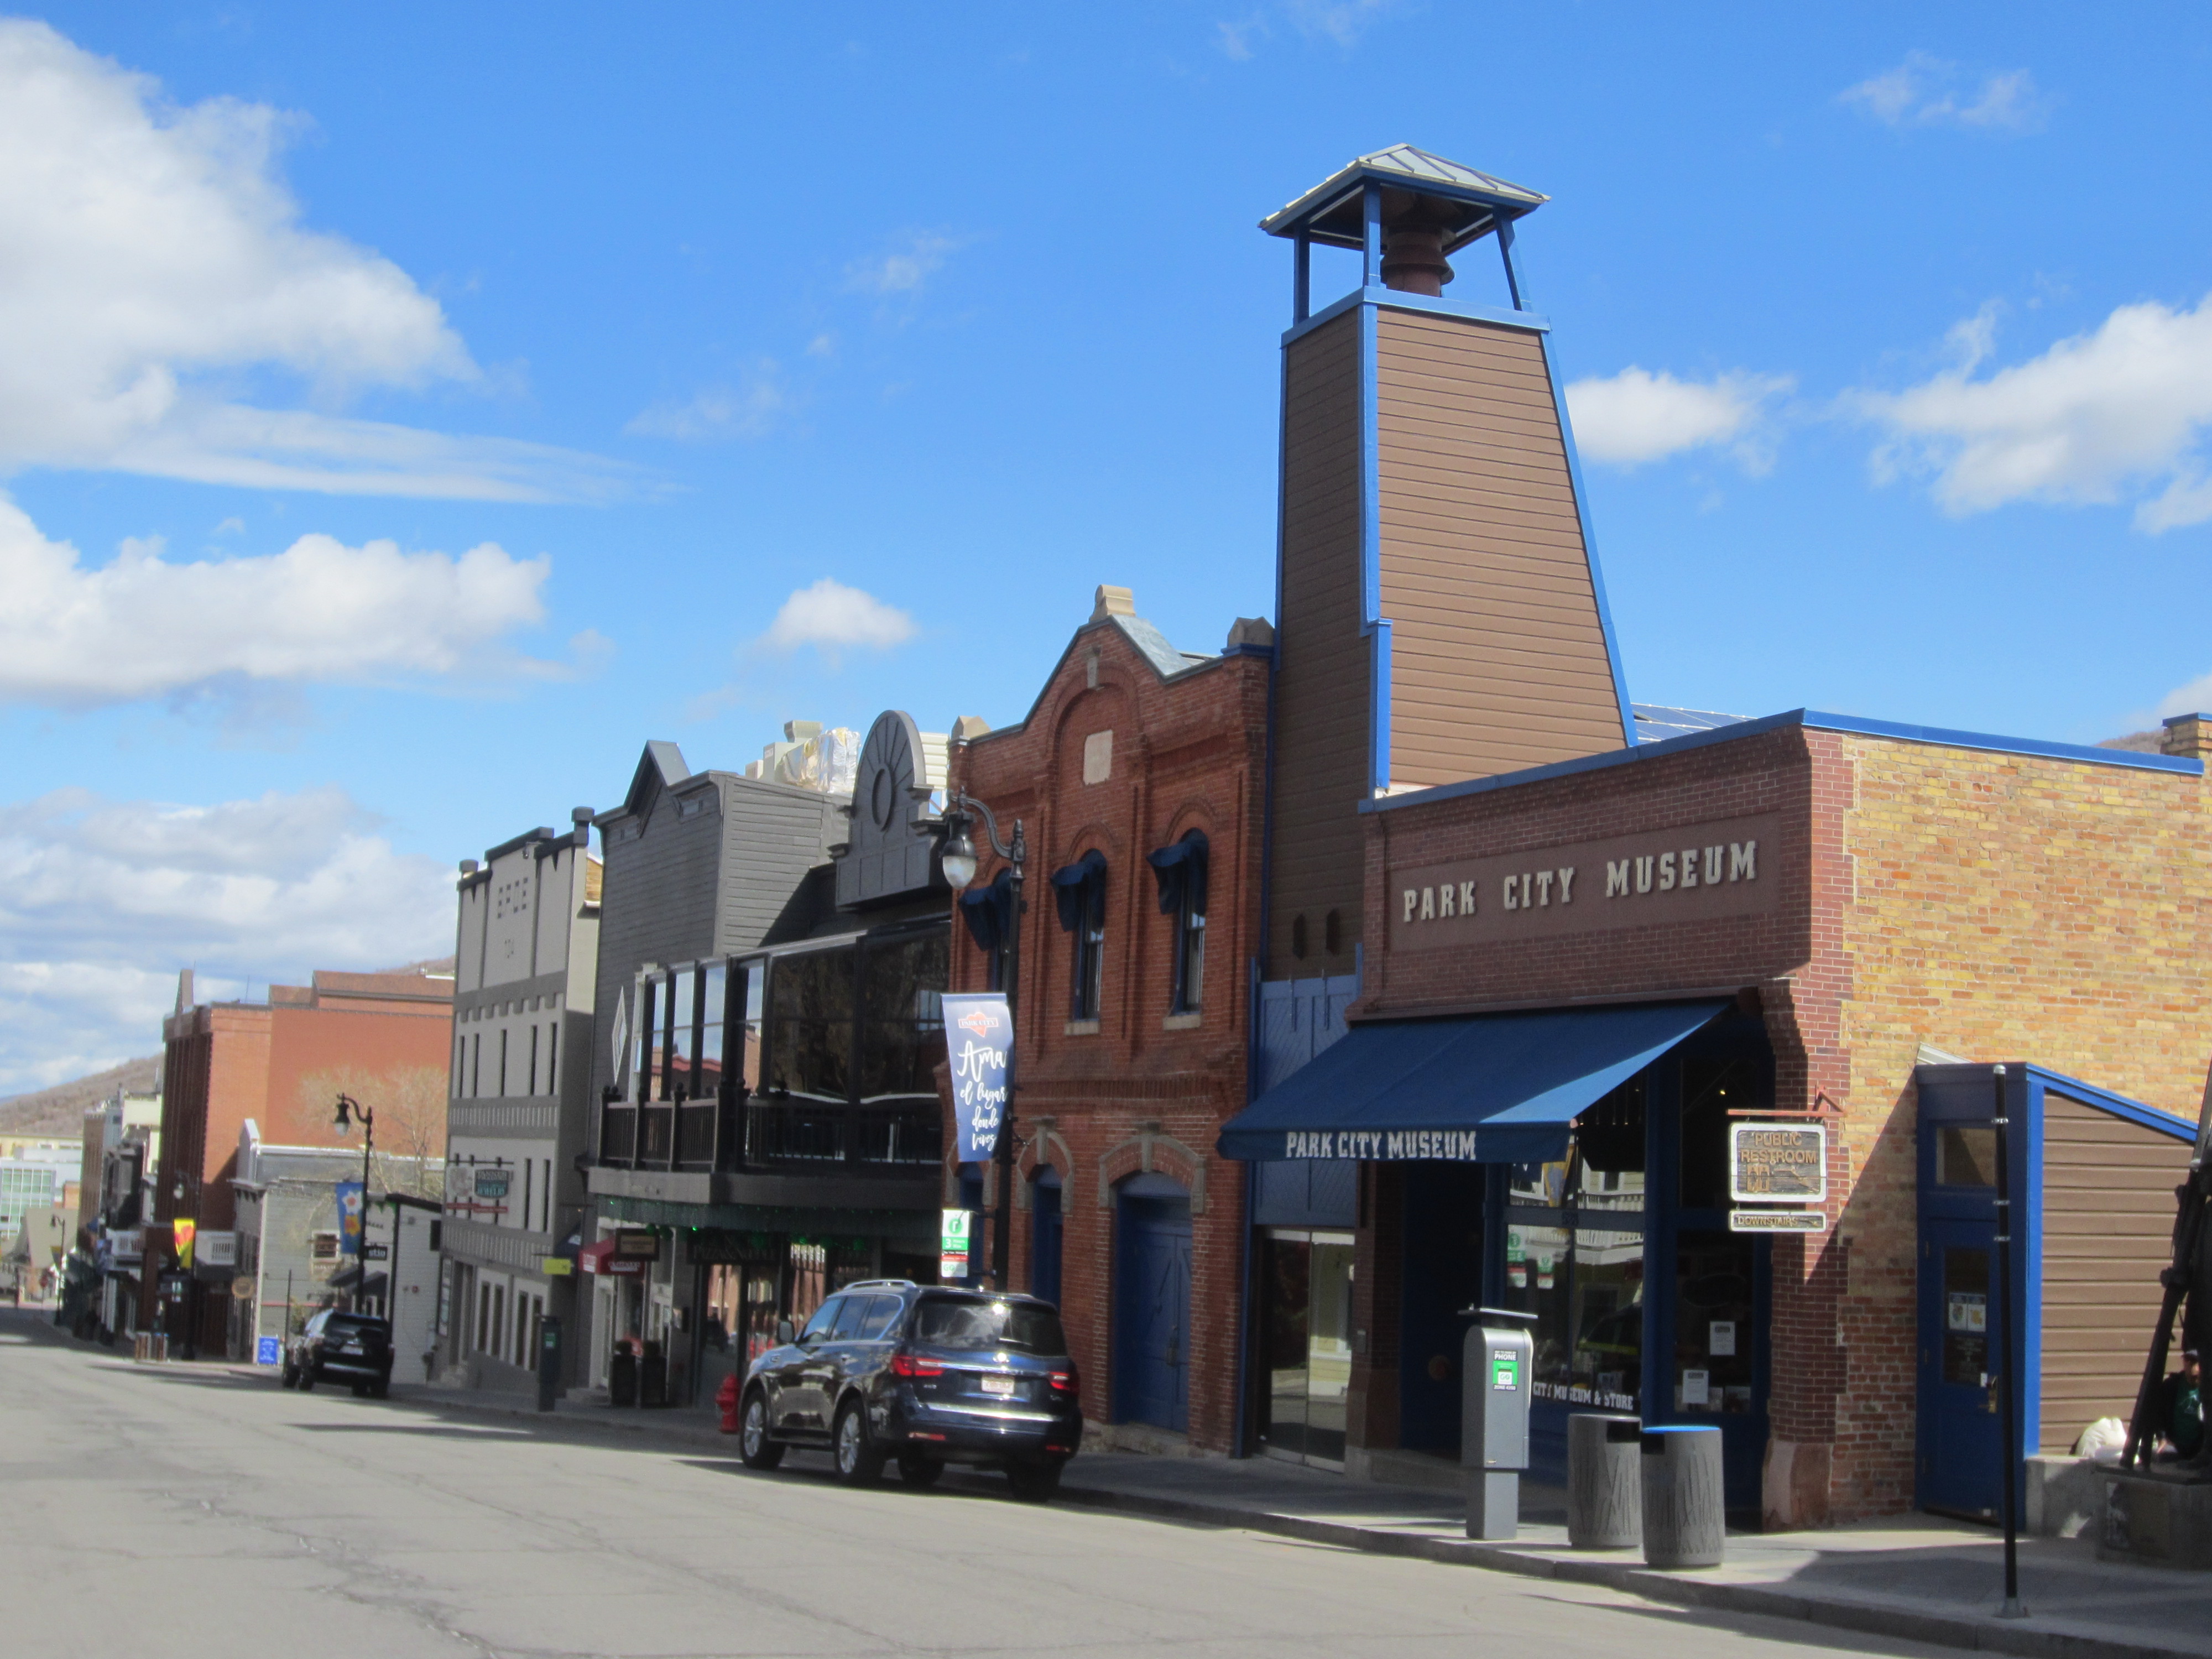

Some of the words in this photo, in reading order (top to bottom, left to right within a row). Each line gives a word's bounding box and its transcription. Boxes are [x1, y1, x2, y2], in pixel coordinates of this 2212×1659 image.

[1403, 881, 1477, 923] PARK
[1503, 867, 1574, 910] CITY
[1605, 840, 1756, 898] MUSEUM
[957, 1040, 1007, 1083] Ama
[959, 1081, 973, 1106] el
[977, 1082, 1008, 1110] lugar
[972, 1105, 999, 1133] donde
[972, 1133, 997, 1152] vives
[1286, 1132, 1333, 1158] PARK
[1337, 1131, 1383, 1159] CITY
[1387, 1131, 1477, 1161] MUSEUM
[1755, 1132, 1802, 1147] PUBLIC
[1740, 1149, 1817, 1165] RESTROOM
[1738, 1215, 1798, 1227] DOWNSTAIRS
[945, 1238, 951, 1249] 3
[1594, 1390, 1601, 1406] &
[1604, 1392, 1634, 1411] STORE
